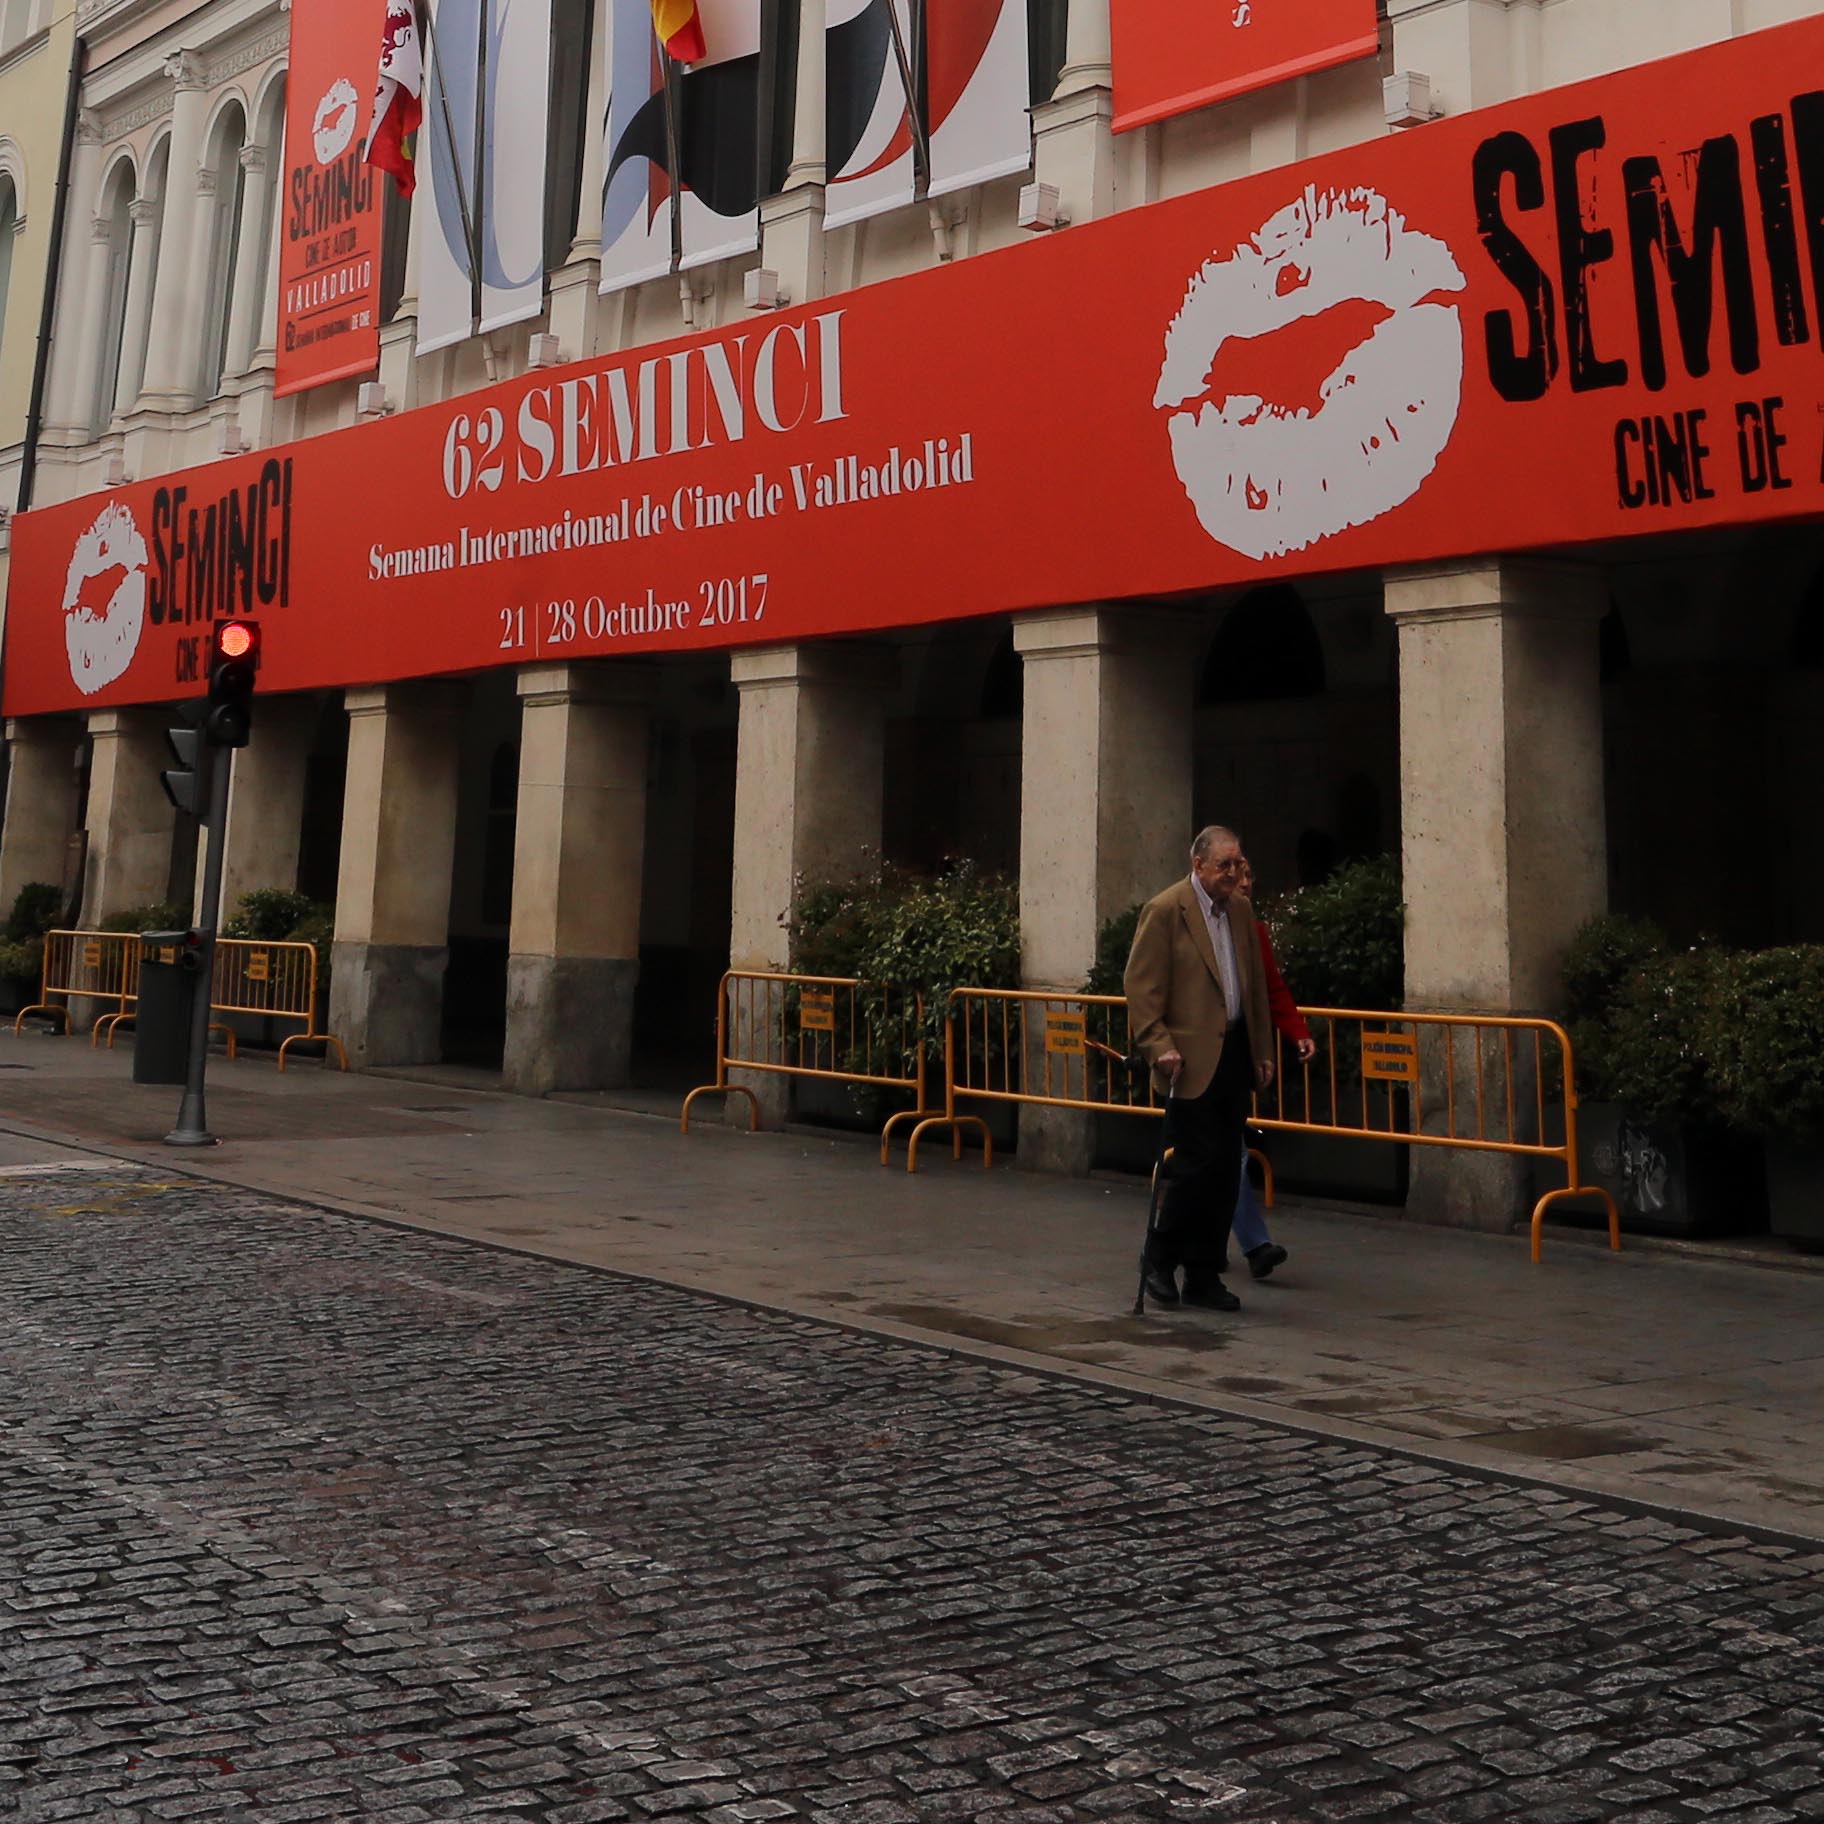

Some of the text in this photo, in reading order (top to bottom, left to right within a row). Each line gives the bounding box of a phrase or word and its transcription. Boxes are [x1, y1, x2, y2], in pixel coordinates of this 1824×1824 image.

[290, 137, 373, 242] SEMINCI
[287, 260, 371, 314] VALLADOLID
[442, 308, 852, 499] 62 SEMINCI
[1614, 408, 1715, 510] CINE
[1734, 396, 1792, 493] DE
[149, 457, 293, 625] SEMINCI
[368, 432, 974, 581] Semana Internacional de Cine de Valladolid
[176, 636, 199, 683] CINE
[499, 607, 526, 650] 21
[547, 597, 576, 644] 28
[583, 587, 691, 639] Octubre
[699, 572, 769, 626] 2017
